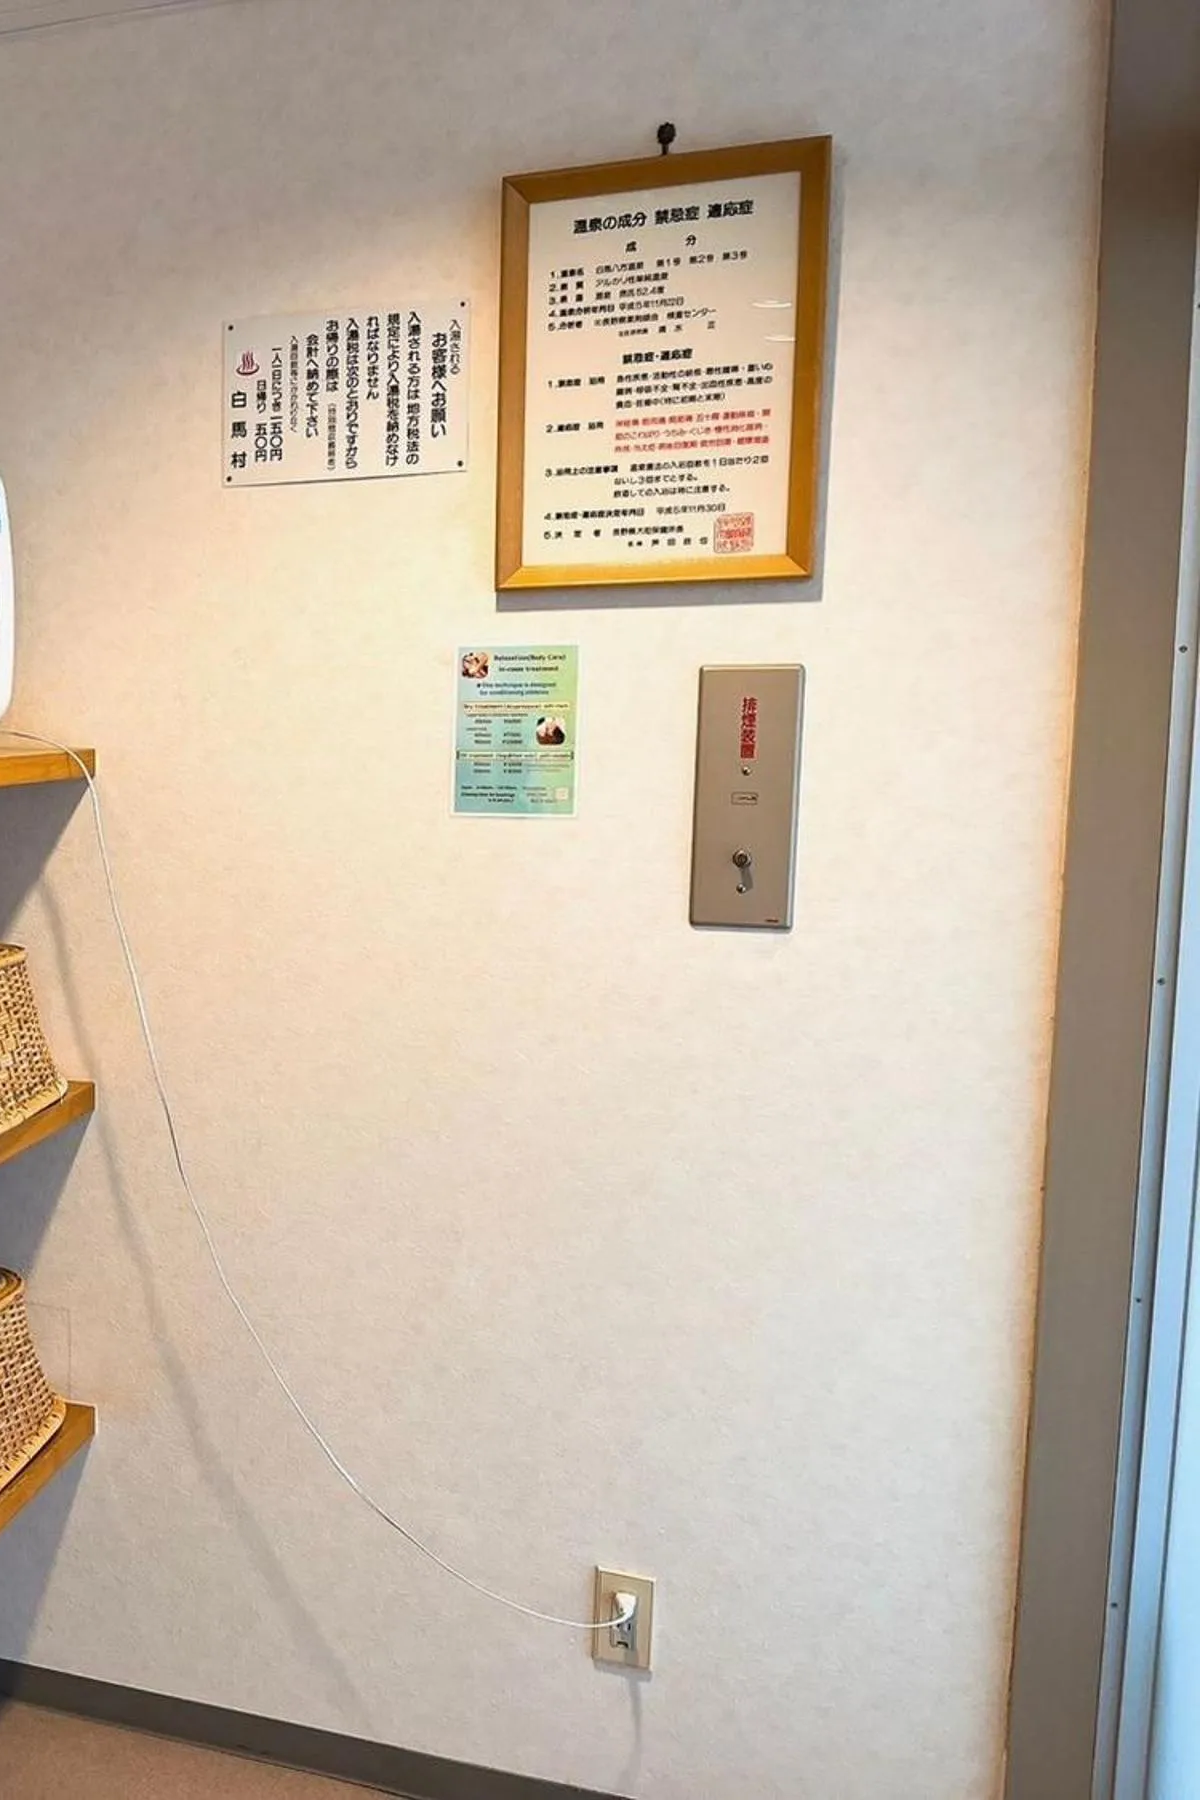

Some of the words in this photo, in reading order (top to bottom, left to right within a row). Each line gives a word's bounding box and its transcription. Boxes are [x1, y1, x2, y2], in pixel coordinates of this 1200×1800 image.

[573, 211, 648, 234] 温泉の成分
[366, 316, 380, 400] ればなりません
[431, 332, 448, 438] お客様へお願い
